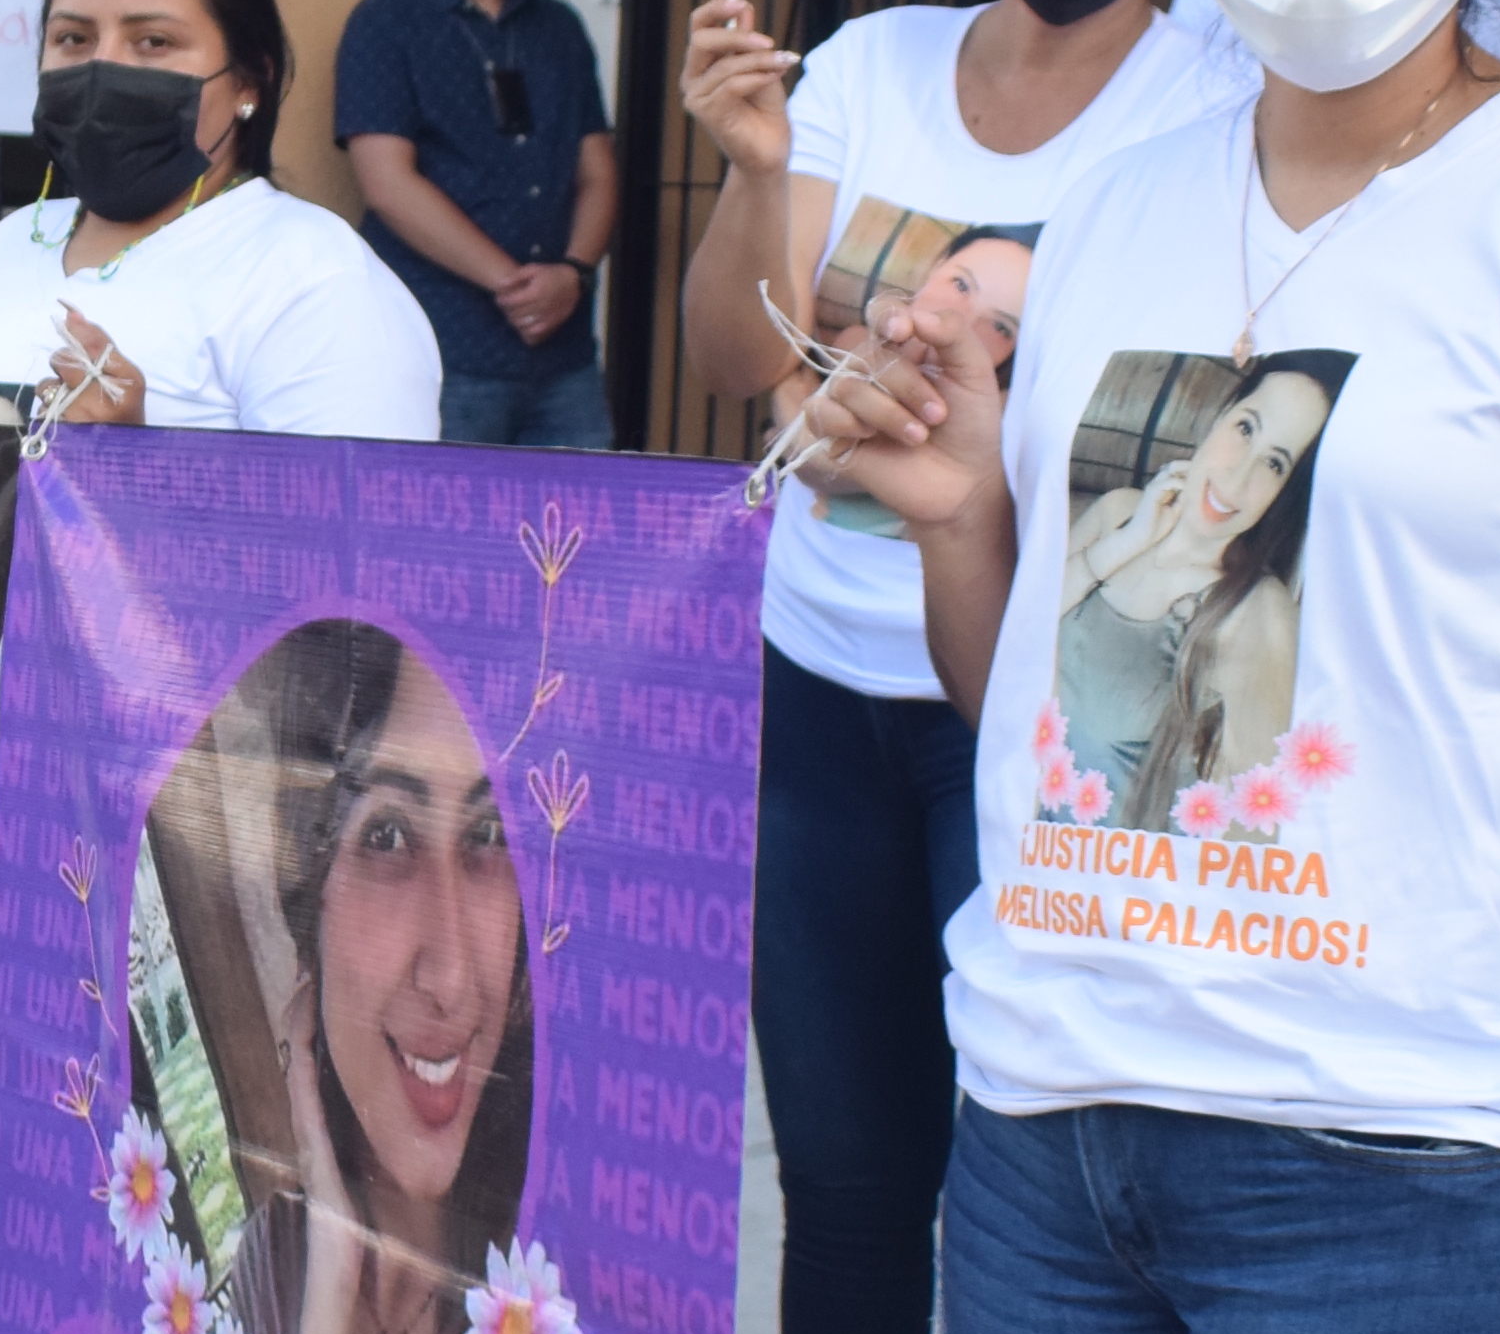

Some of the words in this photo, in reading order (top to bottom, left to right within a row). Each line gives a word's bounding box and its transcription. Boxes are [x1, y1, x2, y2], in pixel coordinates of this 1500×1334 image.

[355, 467, 473, 534] MENOS
[619, 679, 759, 767] MENOS
[614, 773, 757, 865] MENOS
[1019, 822, 1179, 884] ¡JUSTICIA
[1198, 839, 1331, 899] PARA
[606, 872, 753, 967] MENOS
[995, 883, 1109, 939] MELISSA
[1121, 895, 1371, 969] PALACIOS!
[601, 968, 747, 1065] MENOS
[13, 1117, 74, 1188] UNA
[597, 1066, 743, 1166] MENOS
[4, 1190, 65, 1266] UNA
[590, 1157, 741, 1264] MENOS
[1, 1272, 56, 1334] UNA
